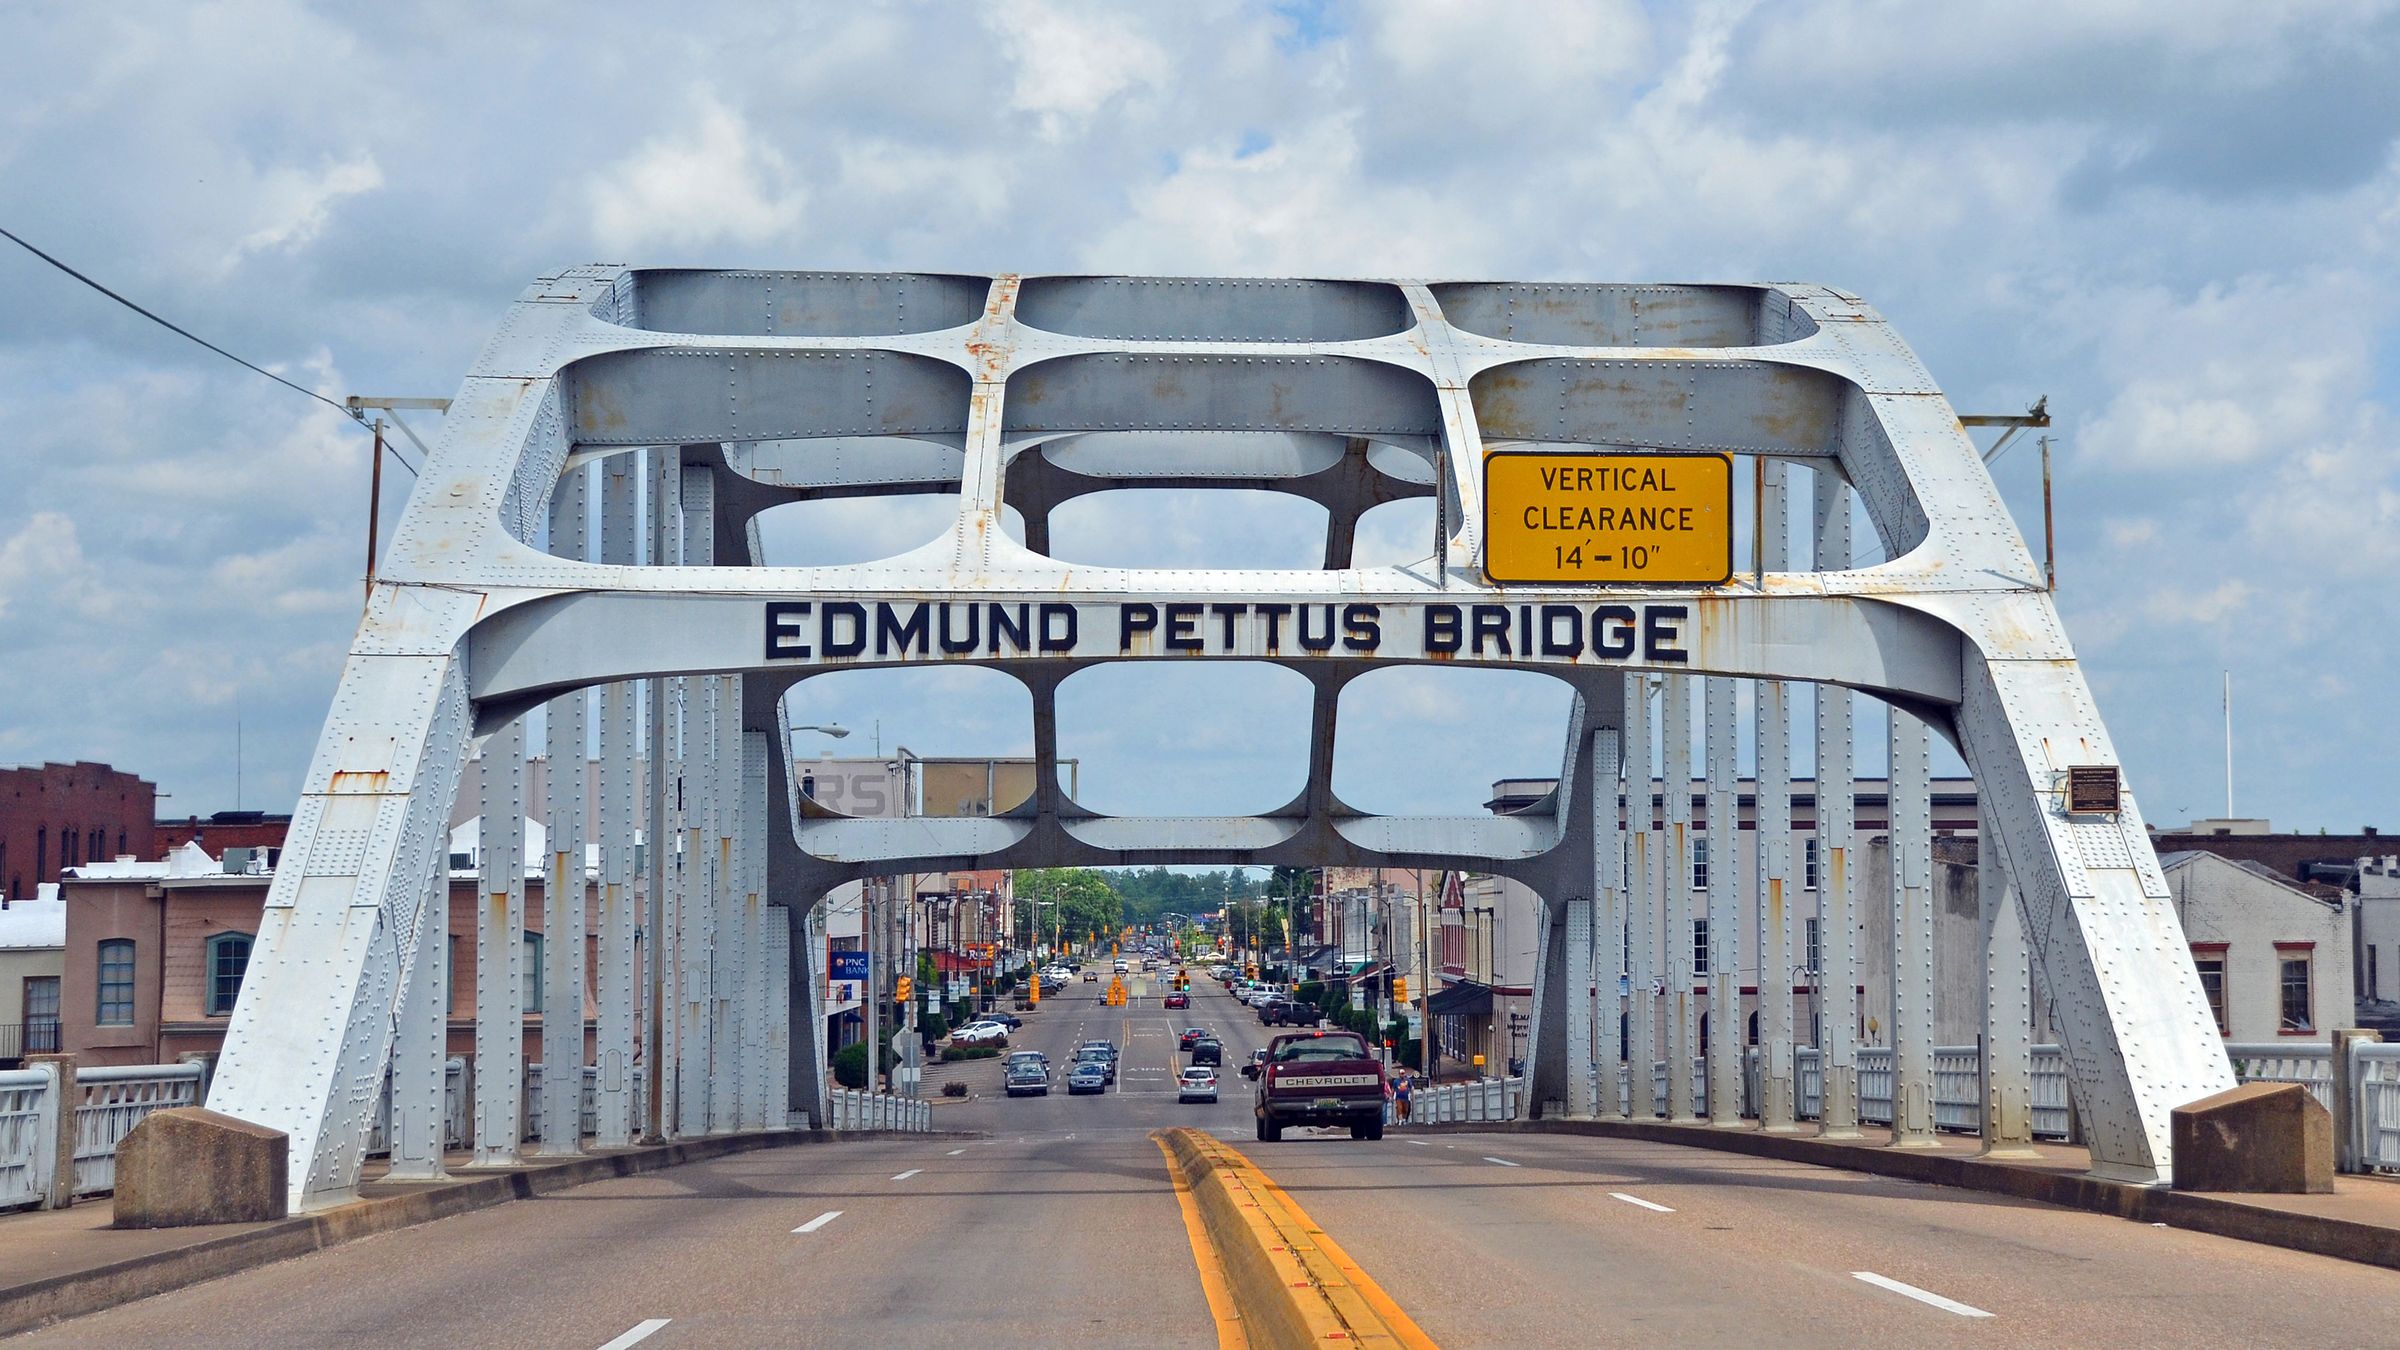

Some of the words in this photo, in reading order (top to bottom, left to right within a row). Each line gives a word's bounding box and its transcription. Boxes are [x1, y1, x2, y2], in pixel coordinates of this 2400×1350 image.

[1540, 467, 1676, 492] VERTICAL
[1523, 506, 1694, 531] CLEARANCE
[765, 601, 1078, 660] EDMUND
[1120, 602, 1381, 652] PETTUS
[1424, 604, 1689, 663] BRIDGE
[845, 958, 865, 967] PNC
[845, 966, 869, 975] BANK
[1285, 1076, 1368, 1086] CHEVROLET
